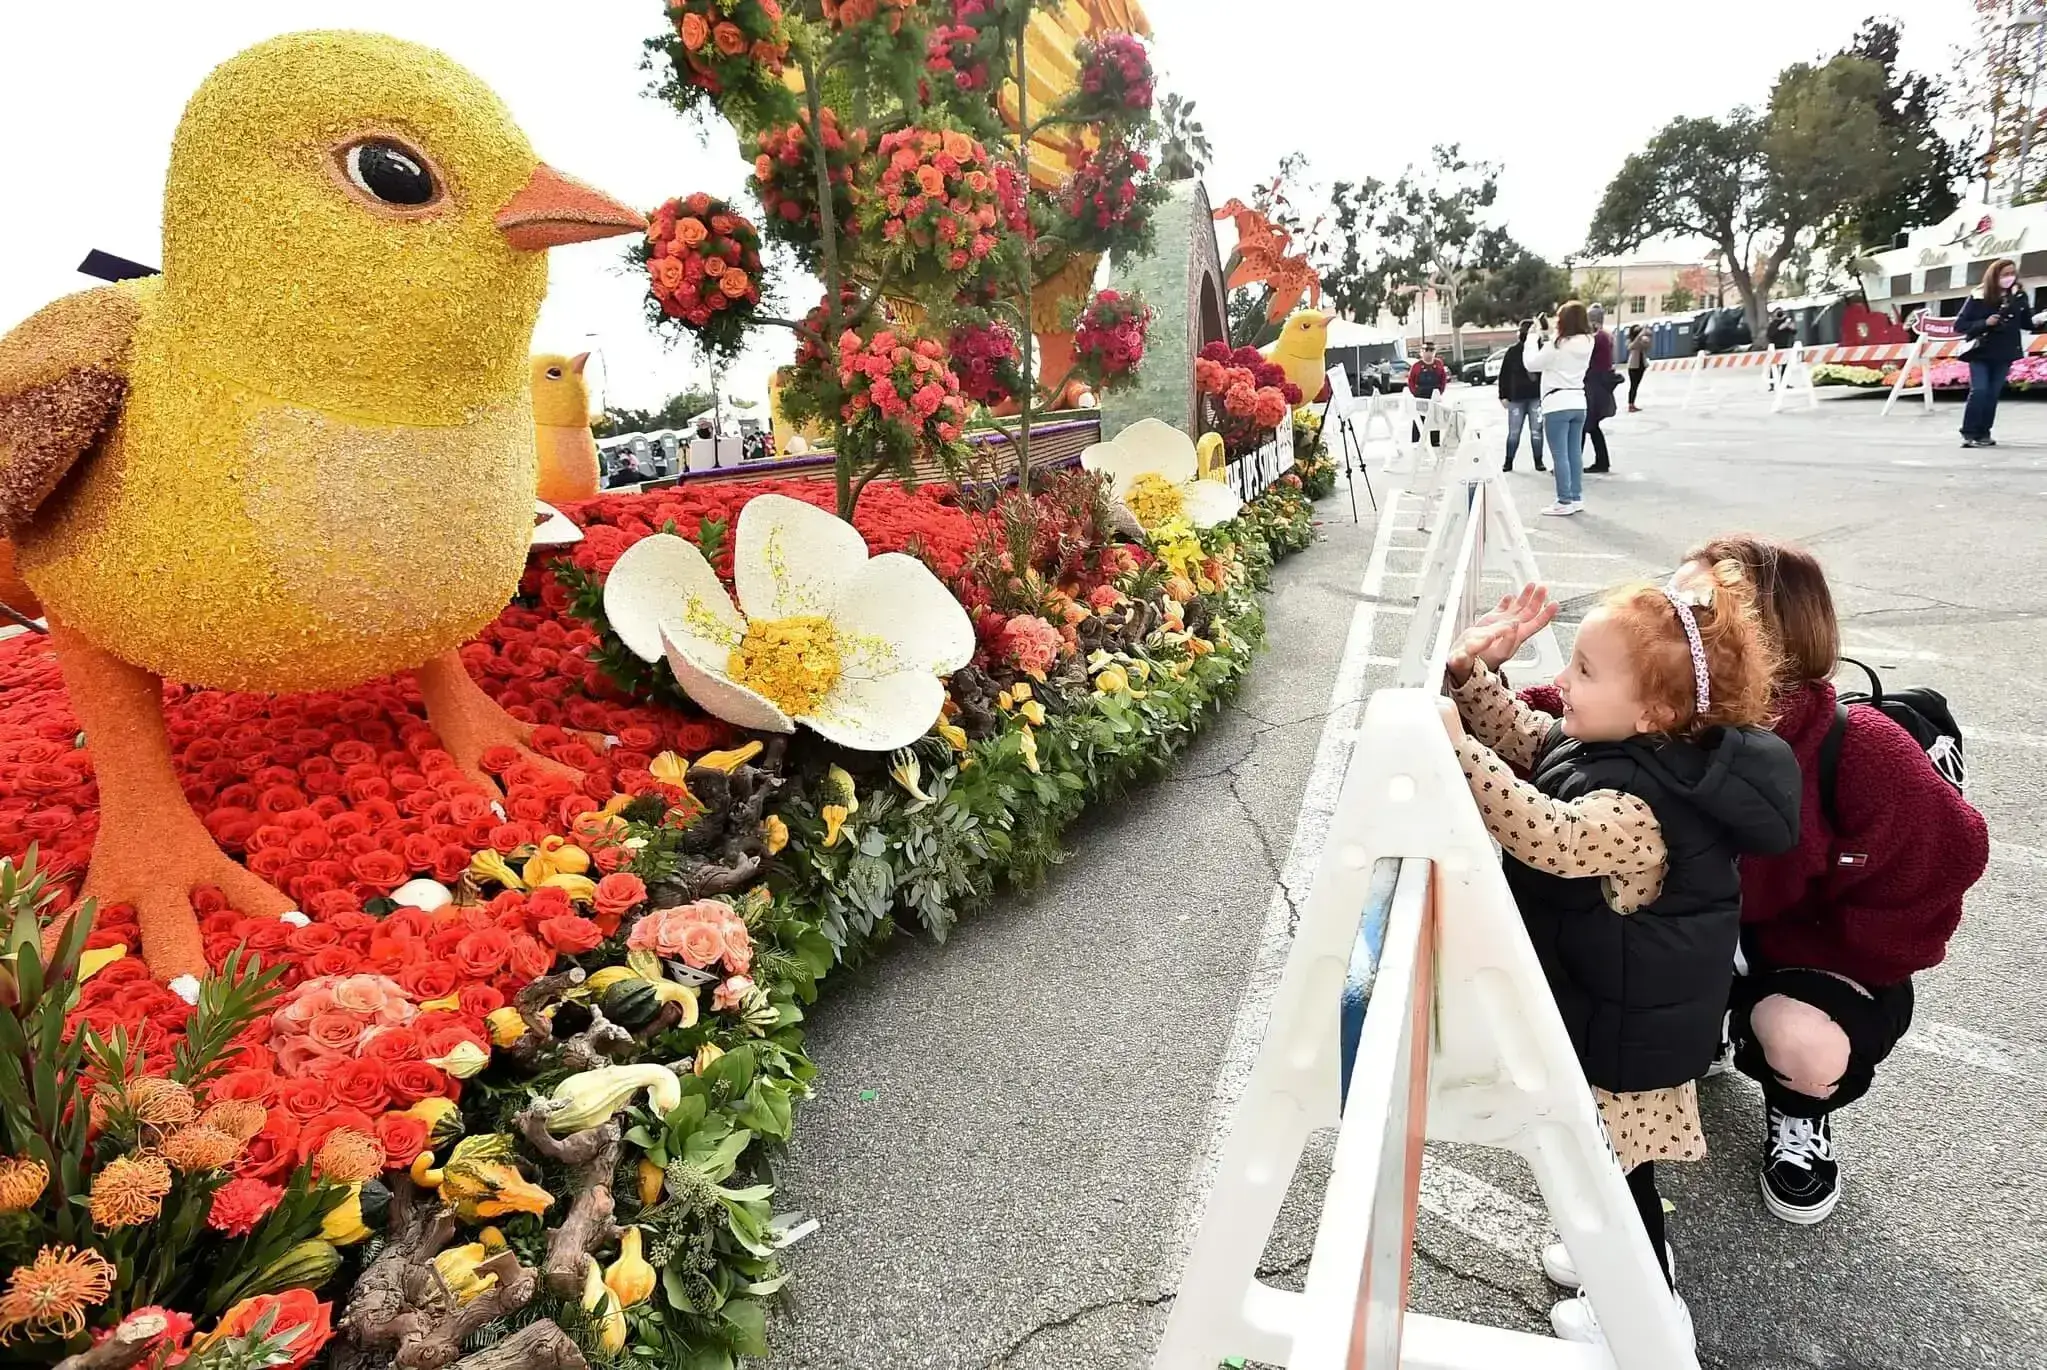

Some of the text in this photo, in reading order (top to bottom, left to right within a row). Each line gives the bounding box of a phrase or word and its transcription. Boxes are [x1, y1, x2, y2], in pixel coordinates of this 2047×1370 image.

[1915, 227, 2029, 268] Rose Bowl
[1242, 451, 1259, 503] UPS
[1259, 440, 1280, 492] STORE
